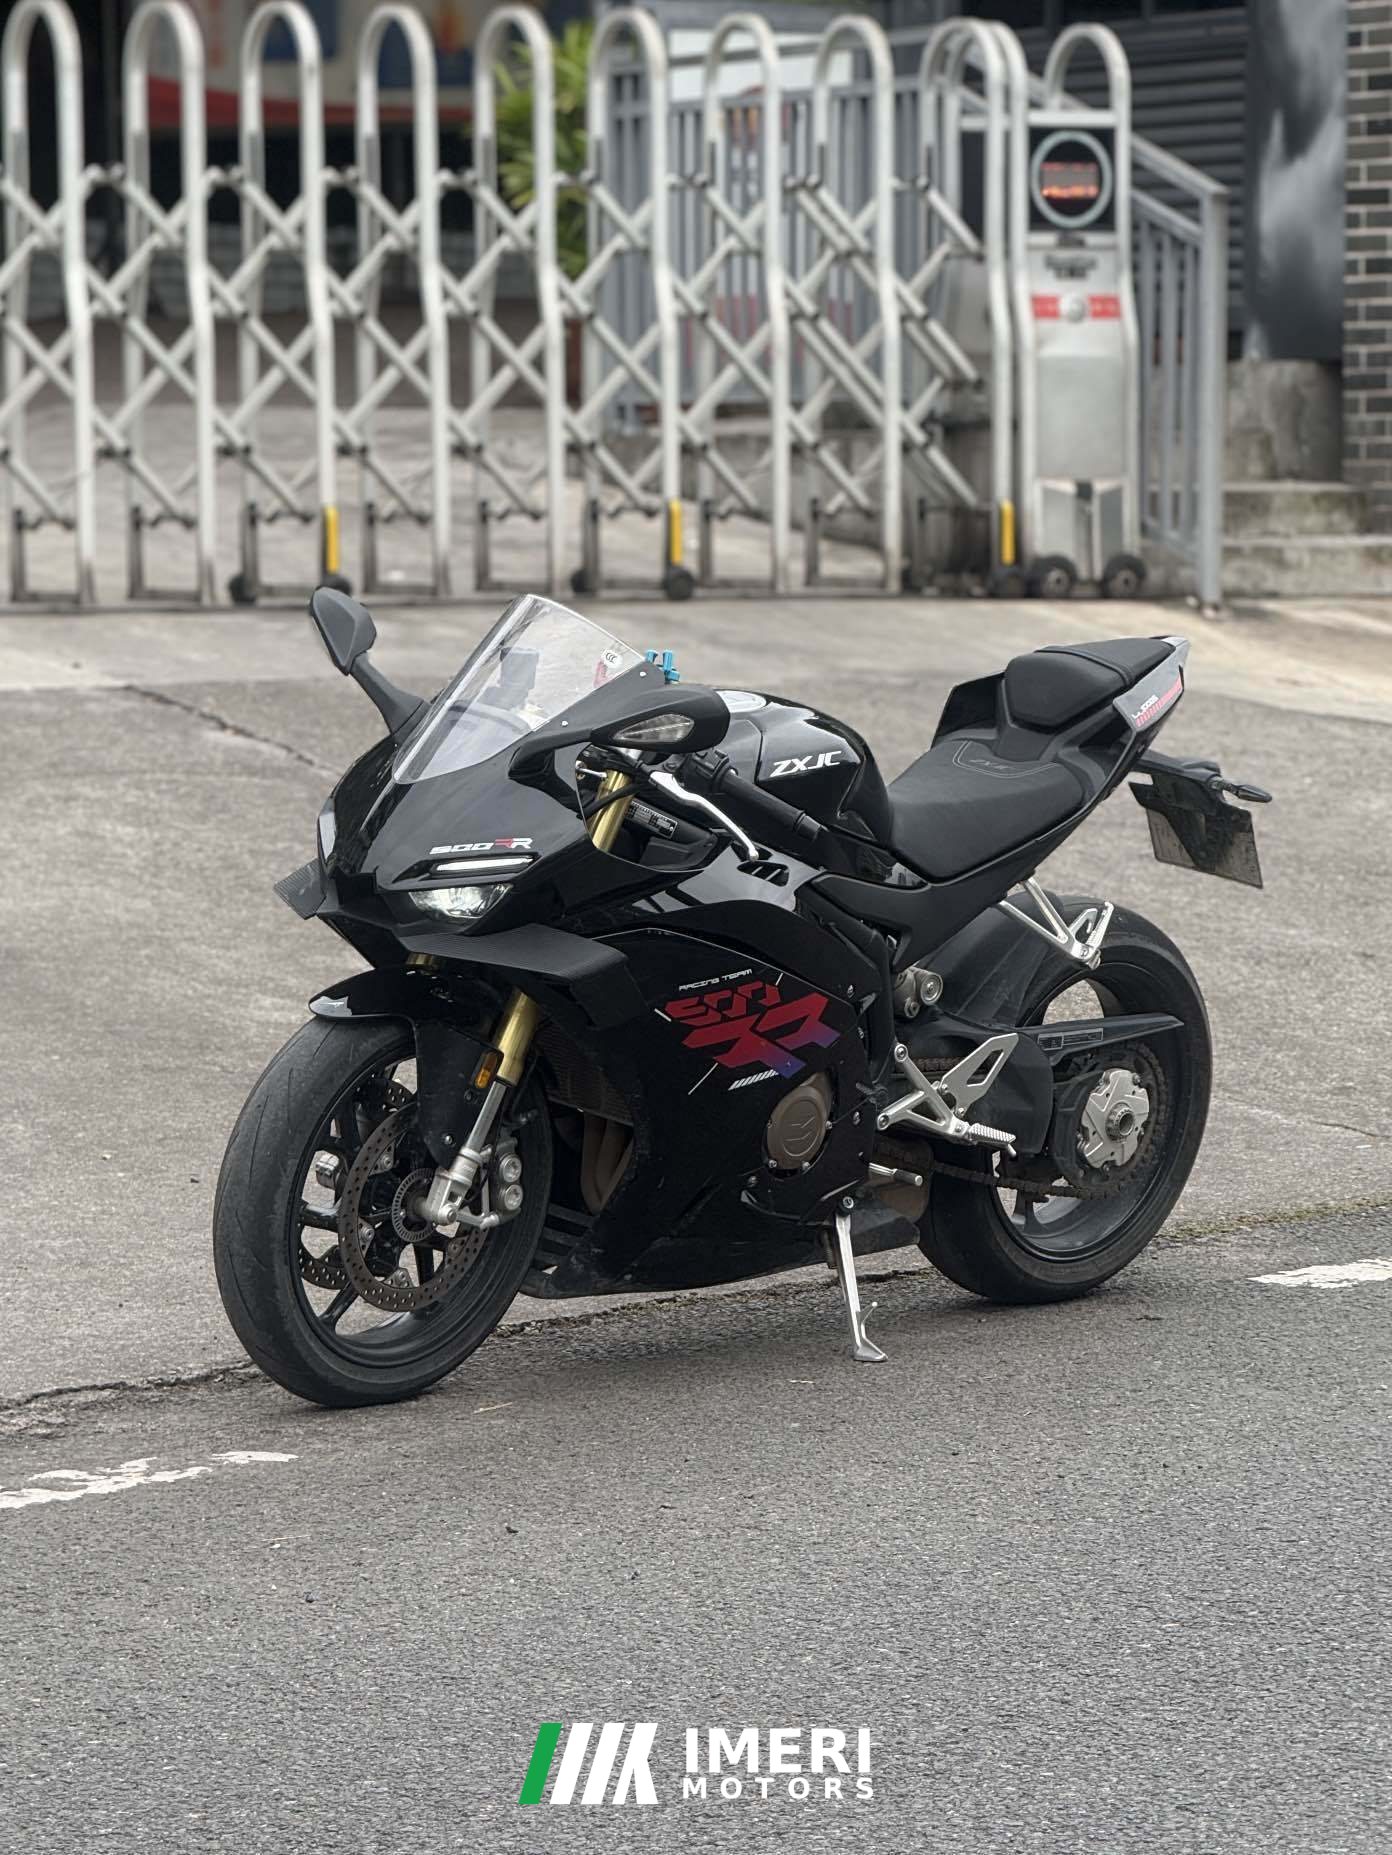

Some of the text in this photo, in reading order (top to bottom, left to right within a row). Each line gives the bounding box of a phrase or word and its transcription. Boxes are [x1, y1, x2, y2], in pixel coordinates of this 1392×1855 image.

[769, 750, 842, 778] ZXJC
[678, 968, 753, 992] RACING TEAM
